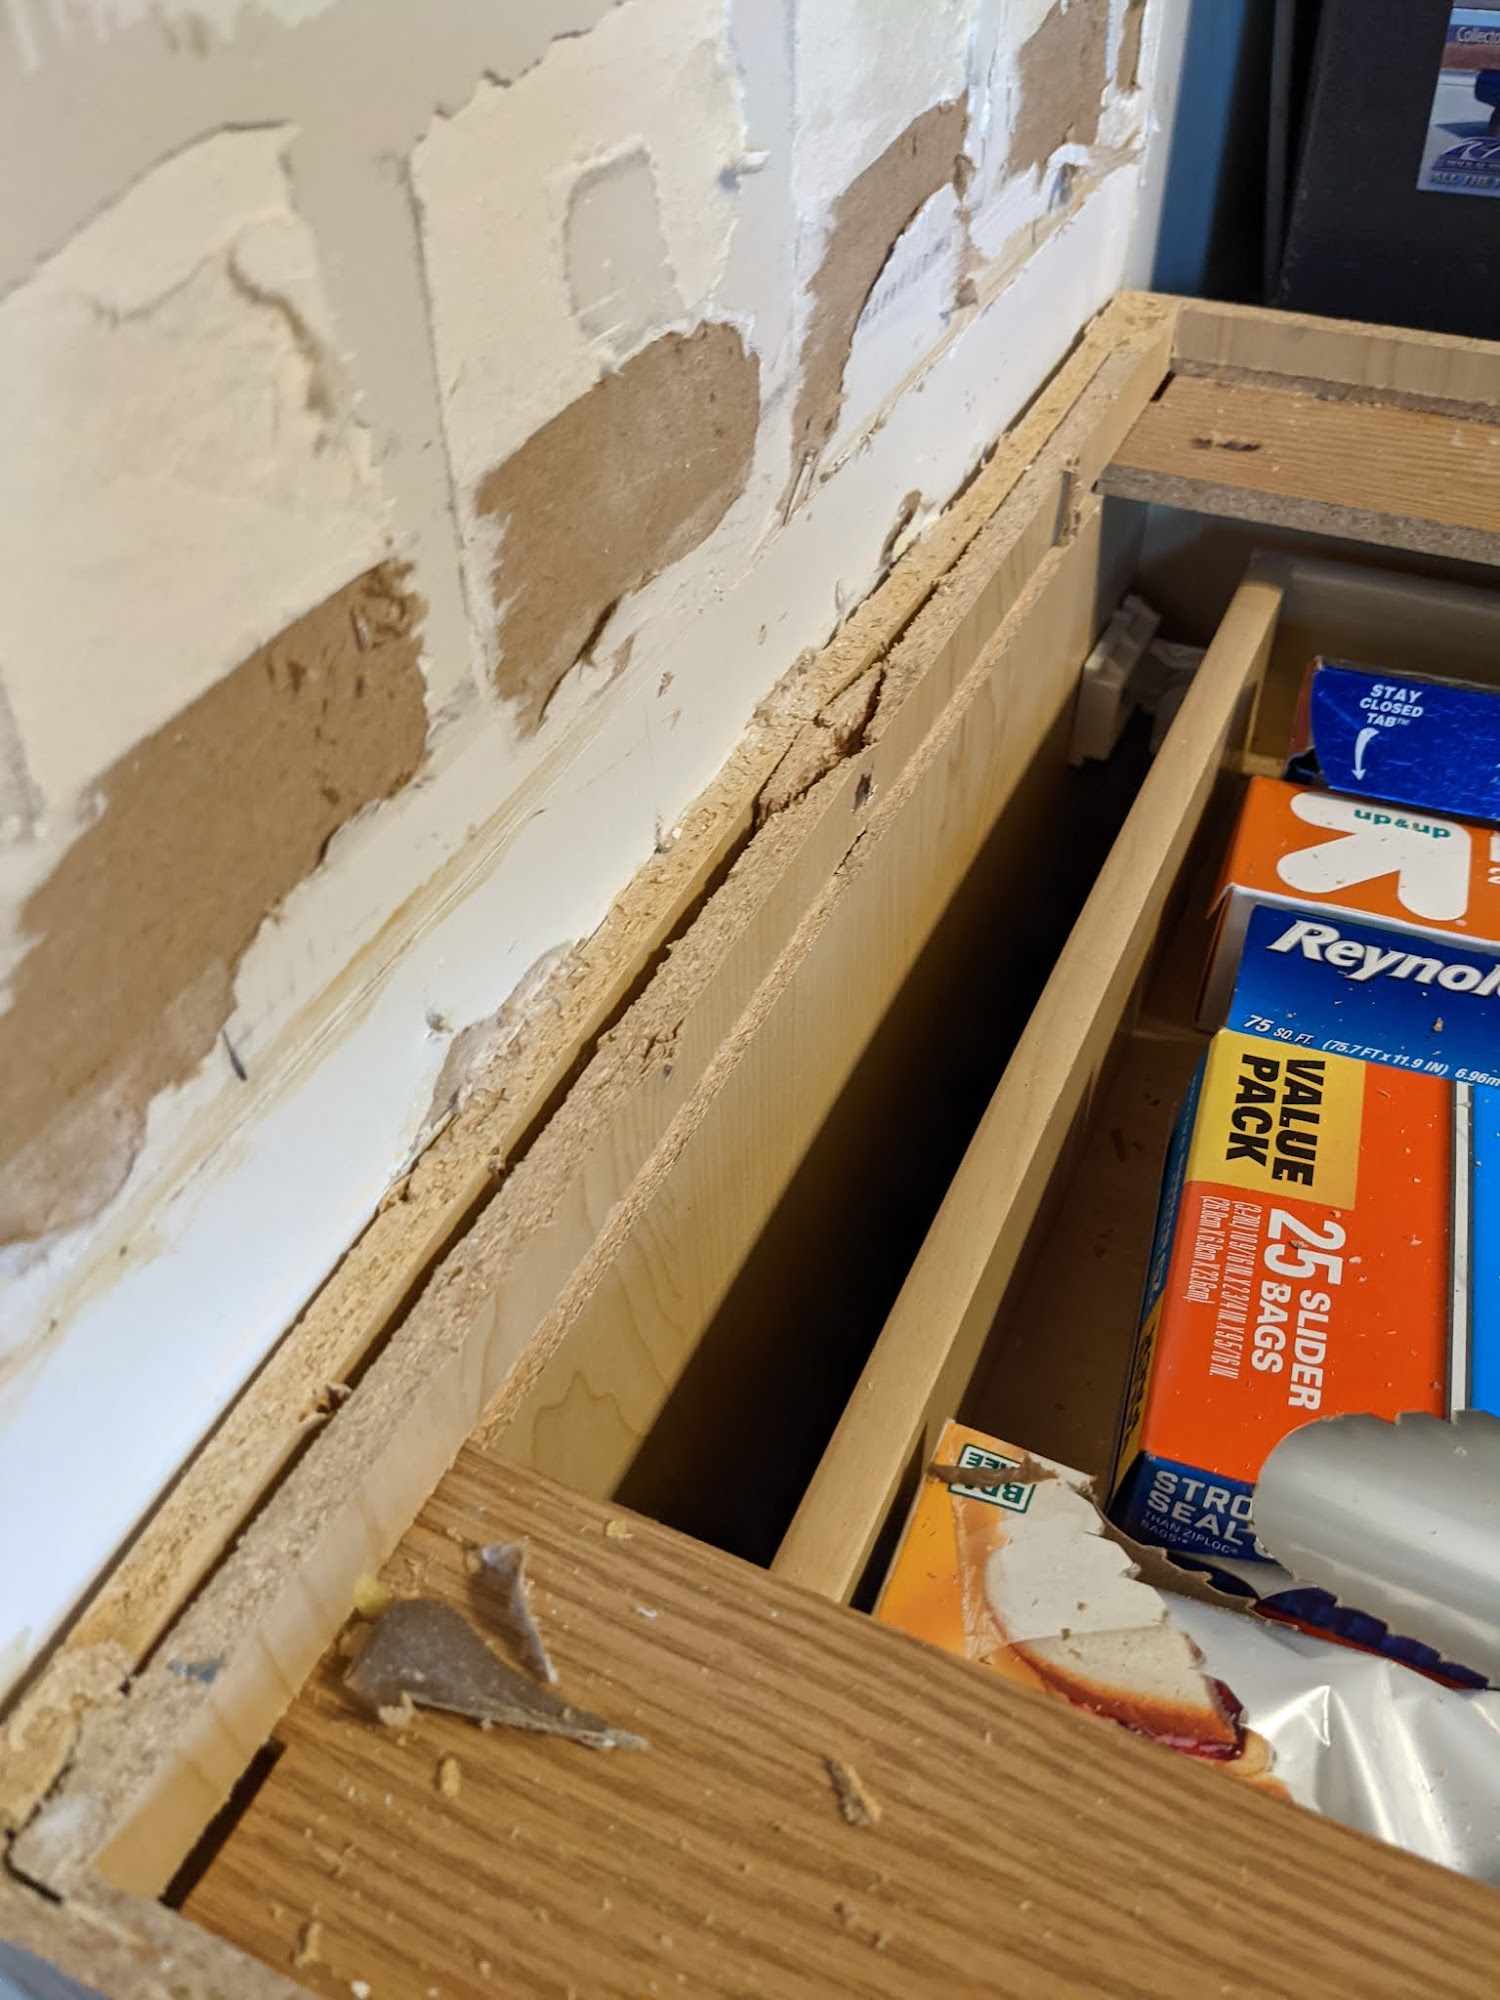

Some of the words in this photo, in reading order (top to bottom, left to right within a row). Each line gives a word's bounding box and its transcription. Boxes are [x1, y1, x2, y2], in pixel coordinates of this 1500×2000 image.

[1359, 697, 1424, 717] CLOSED
[1370, 684, 1423, 703] STAY
[1353, 809, 1451, 839] up&up
[1265, 919, 1500, 997] Reynol
[1243, 1014, 1275, 1033] 75
[1273, 1027, 1293, 1041] SQ.
[1294, 1033, 1314, 1045] FT.
[1322, 1039, 1364, 1054] (75.7
[1360, 1047, 1381, 1061] FT
[1390, 1053, 1421, 1069] 11.9
[1423, 1059, 1449, 1076] IN)
[1225, 1053, 1280, 1167] PACK
[1271, 1058, 1326, 1186] VALUE
[1200, 1195, 1231, 1228] (26.8cm
[1228, 1200, 1263, 1232] (3.78L)
[1193, 1234, 1225, 1261] 6.9cm
[1230, 1230, 1258, 1244] 10
[1263, 1208, 1346, 1286] 25
[1226, 1241, 1257, 1265] 9/16
[1225, 1262, 1253, 1277] IN.
[1219, 1291, 1250, 1311] 3/4
[1222, 1283, 1251, 1294] 2
[1217, 1308, 1247, 1324] IN.
[1251, 1280, 1292, 1373] BAGS
[1214, 1330, 1244, 1342] 9
[1288, 1289, 1331, 1410] SLIDER
[1211, 1338, 1243, 1366] 5/16
[1209, 1363, 1239, 1379] IN.
[1153, 1470, 1252, 1521] STRO
[1144, 1509, 1180, 1533] THAN
[1147, 1489, 1243, 1546] SEAL
